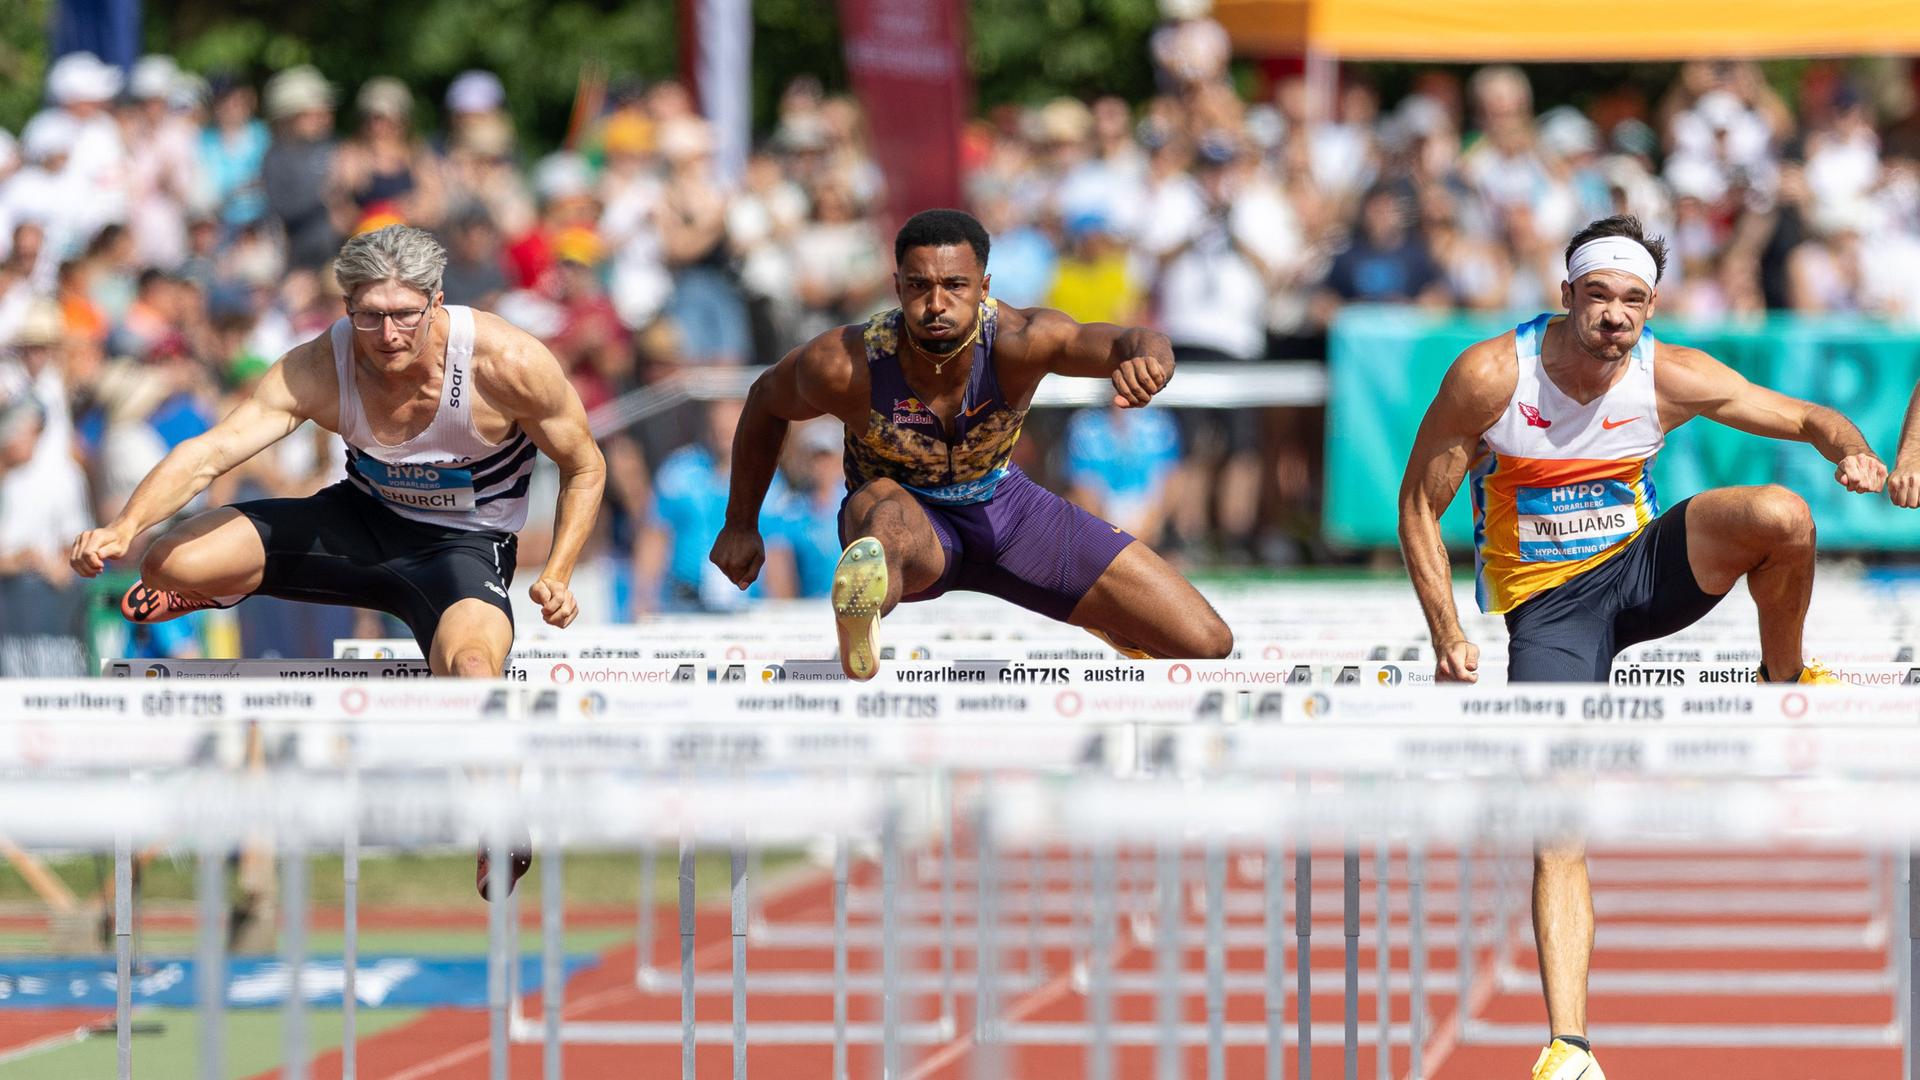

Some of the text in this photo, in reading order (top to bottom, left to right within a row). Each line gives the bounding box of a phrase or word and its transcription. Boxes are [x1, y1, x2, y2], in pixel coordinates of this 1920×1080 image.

[450, 364, 462, 408] soar
[893, 413, 933, 424] Red Bull
[386, 466, 440, 482] HYPO
[388, 480, 441, 490] VORARLBERG
[1552, 483, 1606, 502] HYPO
[381, 489, 456, 506] CHURCH
[1553, 499, 1605, 513] VORARLBERG
[1534, 513, 1626, 536] WILLIAMS
[1535, 545, 1598, 556] HYPOMEETING
[578, 667, 671, 684] wohn.wert
[897, 667, 985, 682] vorarlberg
[999, 663, 1070, 685] GÖTZIS
[1084, 666, 1144, 681] austria
[1197, 668, 1288, 684] wohn.wert
[1614, 664, 1685, 687] GÖTZIS
[1582, 692, 1666, 720] GÖTZIS
